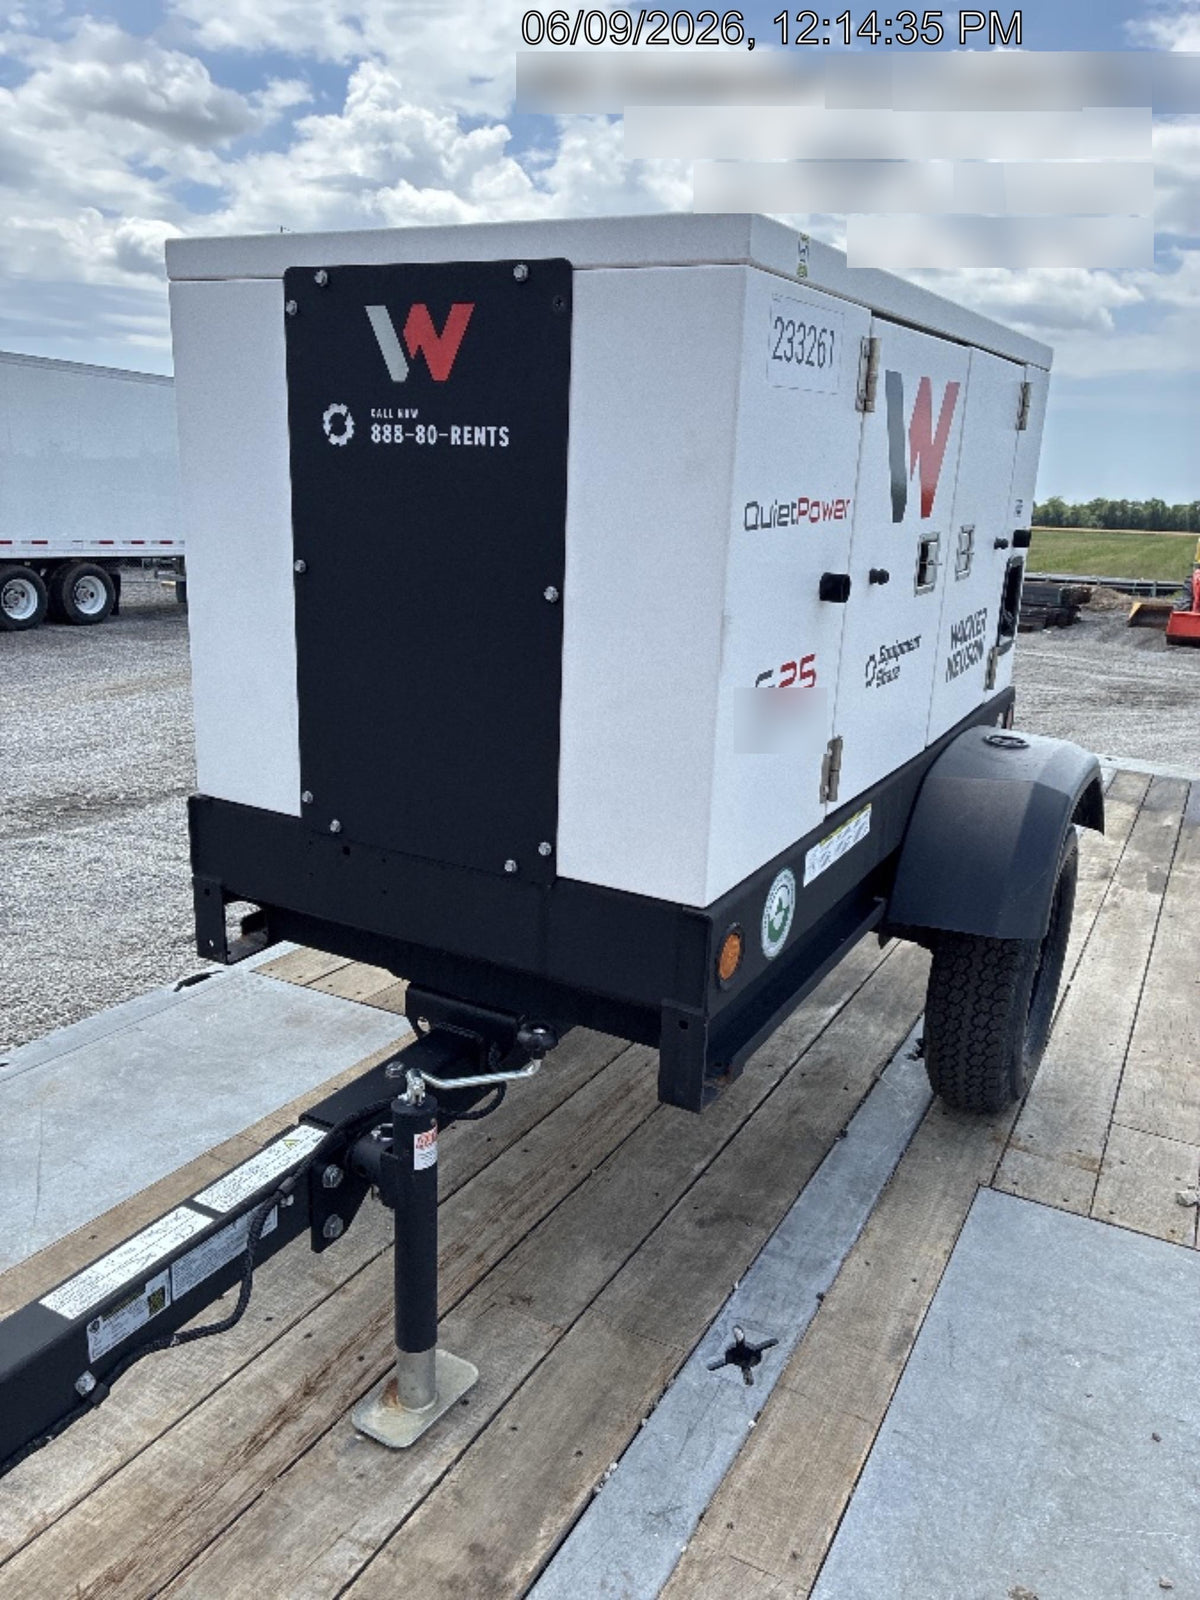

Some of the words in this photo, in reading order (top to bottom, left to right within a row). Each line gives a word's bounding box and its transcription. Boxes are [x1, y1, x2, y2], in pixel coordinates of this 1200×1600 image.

[771, 316, 836, 368] 233261
[370, 408, 394, 419] CALL
[744, 497, 851, 532] QuietPower
